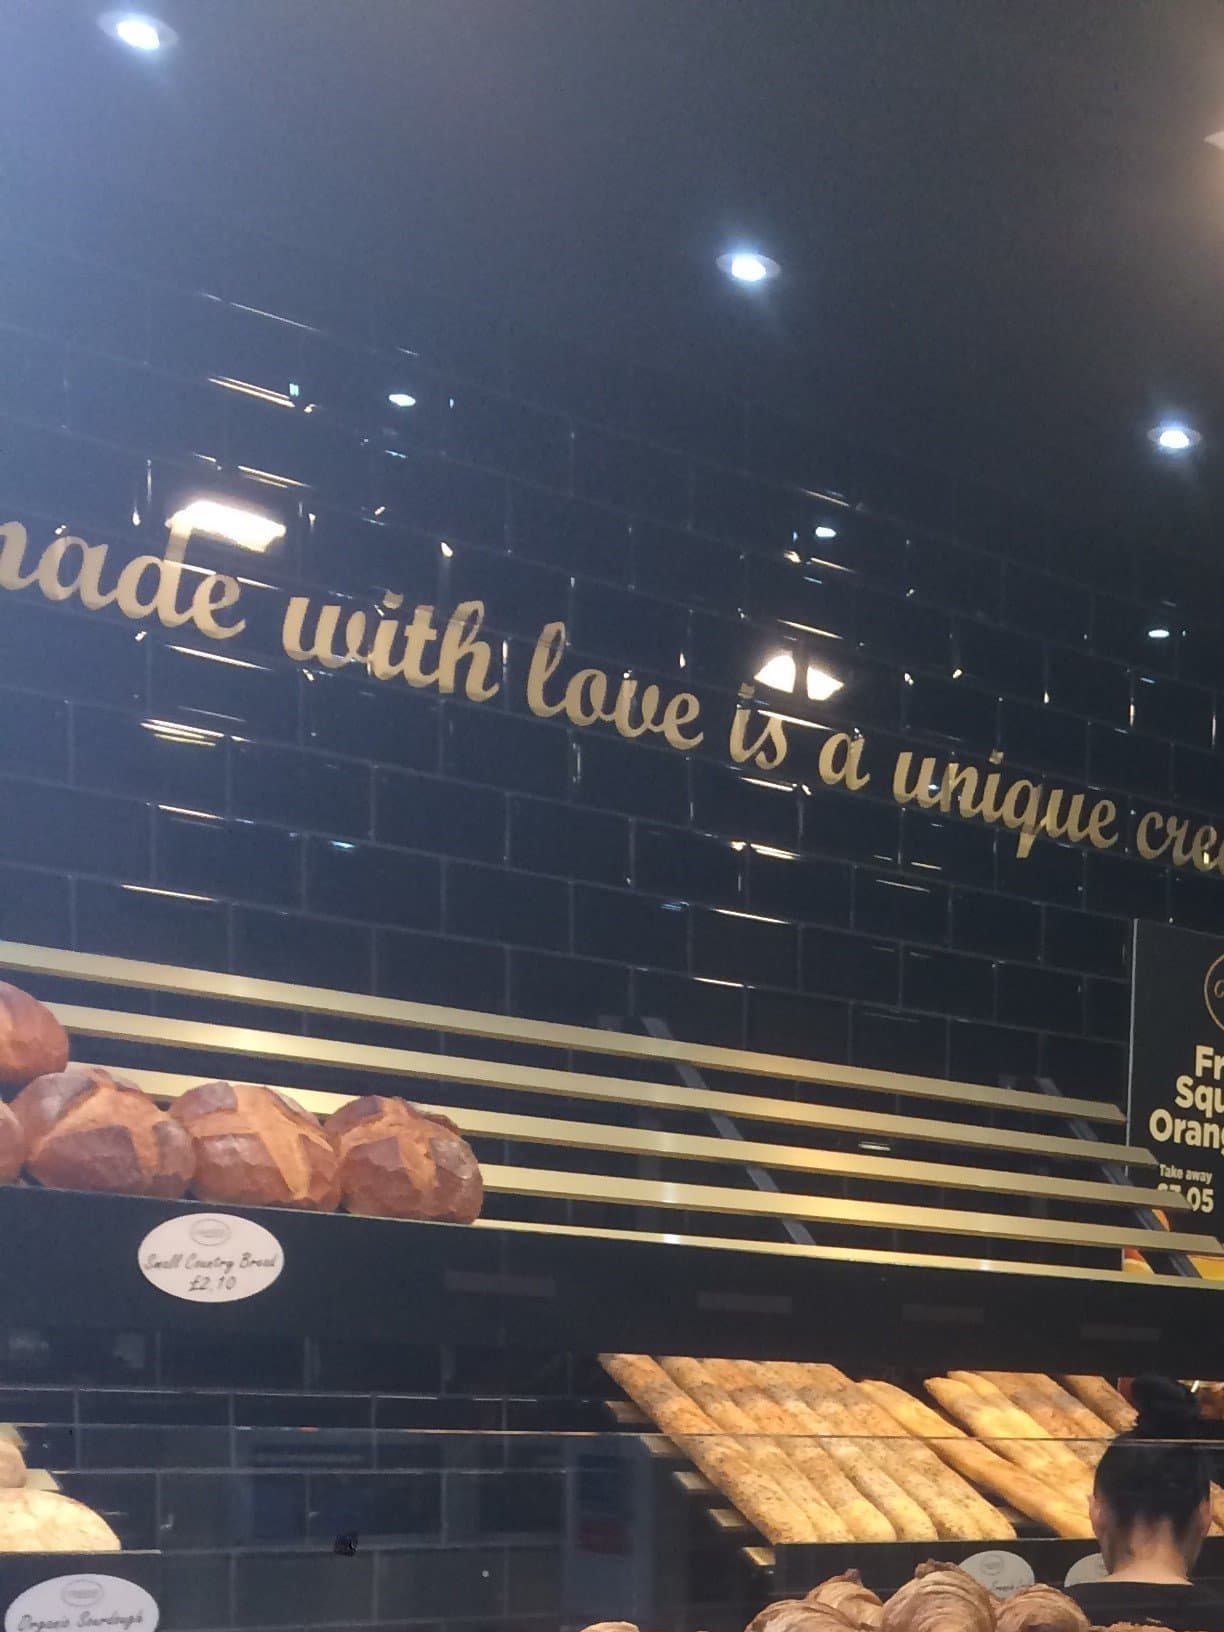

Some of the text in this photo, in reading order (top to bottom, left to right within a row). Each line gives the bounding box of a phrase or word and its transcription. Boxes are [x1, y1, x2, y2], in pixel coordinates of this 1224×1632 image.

[282, 593, 501, 702] with
[526, 621, 704, 750] love
[728, 681, 789, 771] is
[817, 728, 871, 792] a
[891, 750, 1119, 859] unique
[1159, 1164, 1213, 1185] Take away
[145, 1252, 279, 1274] Small Country Bread
[188, 1275, 236, 1292] £2.10
